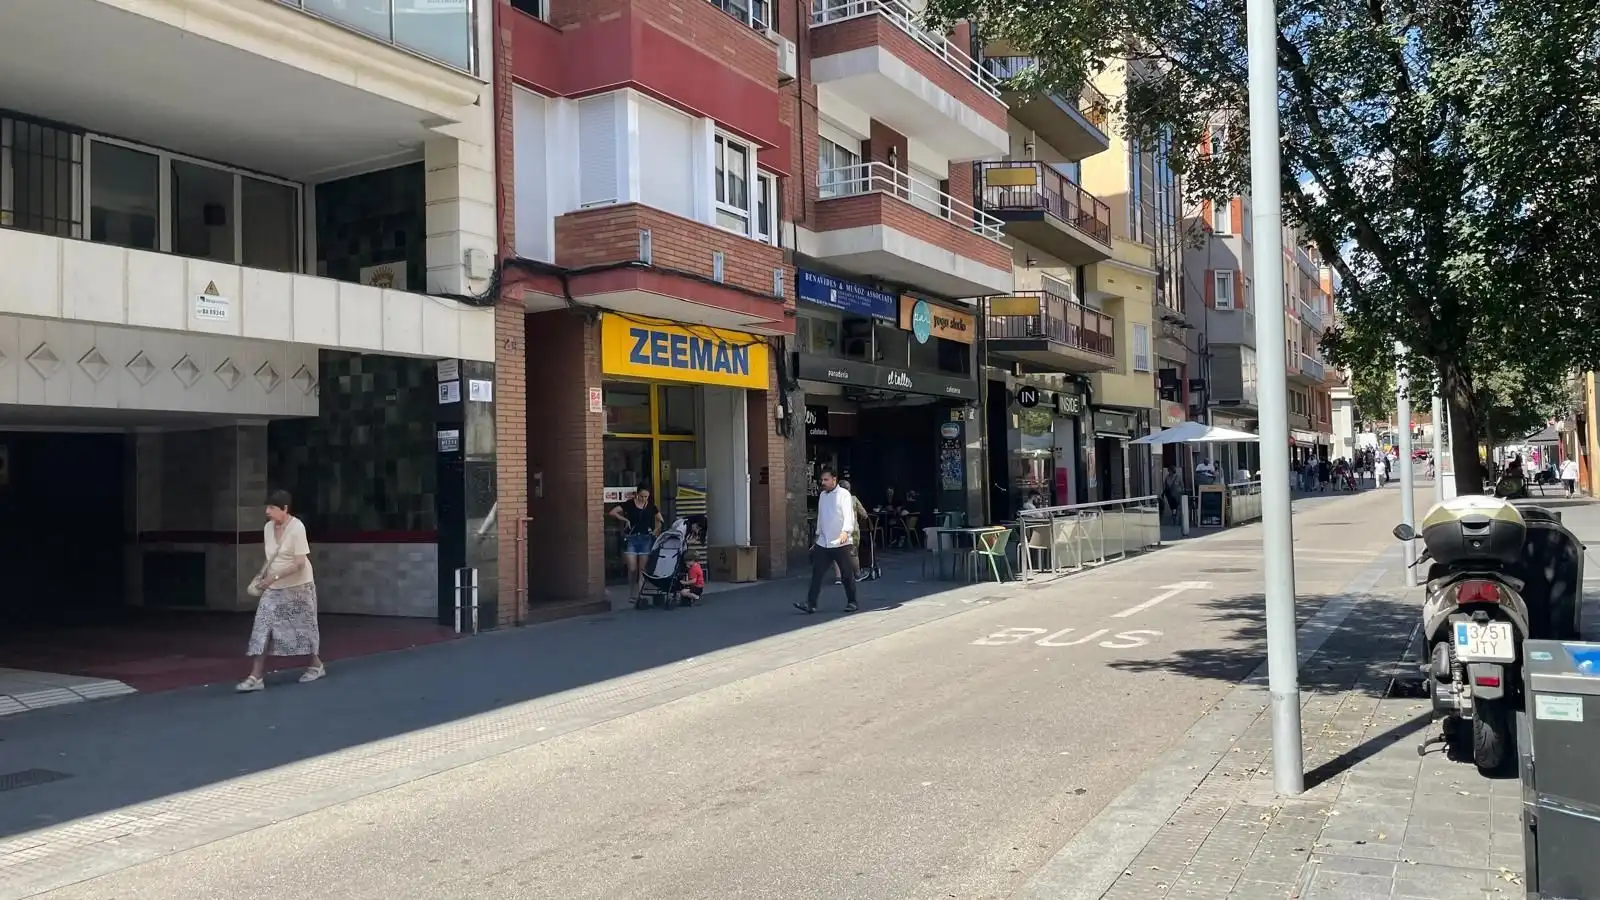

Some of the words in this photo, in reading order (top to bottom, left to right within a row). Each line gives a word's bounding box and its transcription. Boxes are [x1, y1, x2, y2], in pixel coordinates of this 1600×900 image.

[805, 272, 837, 288] BENAVIDES
[839, 282, 844, 290] &
[845, 284, 865, 296] MUÑOZ
[629, 327, 749, 376] ZEEMAN
[1021, 391, 1035, 403] IN
[968, 627, 1164, 649] BUS
[1471, 625, 1506, 640] 3751
[1471, 641, 1497, 655] JTY
